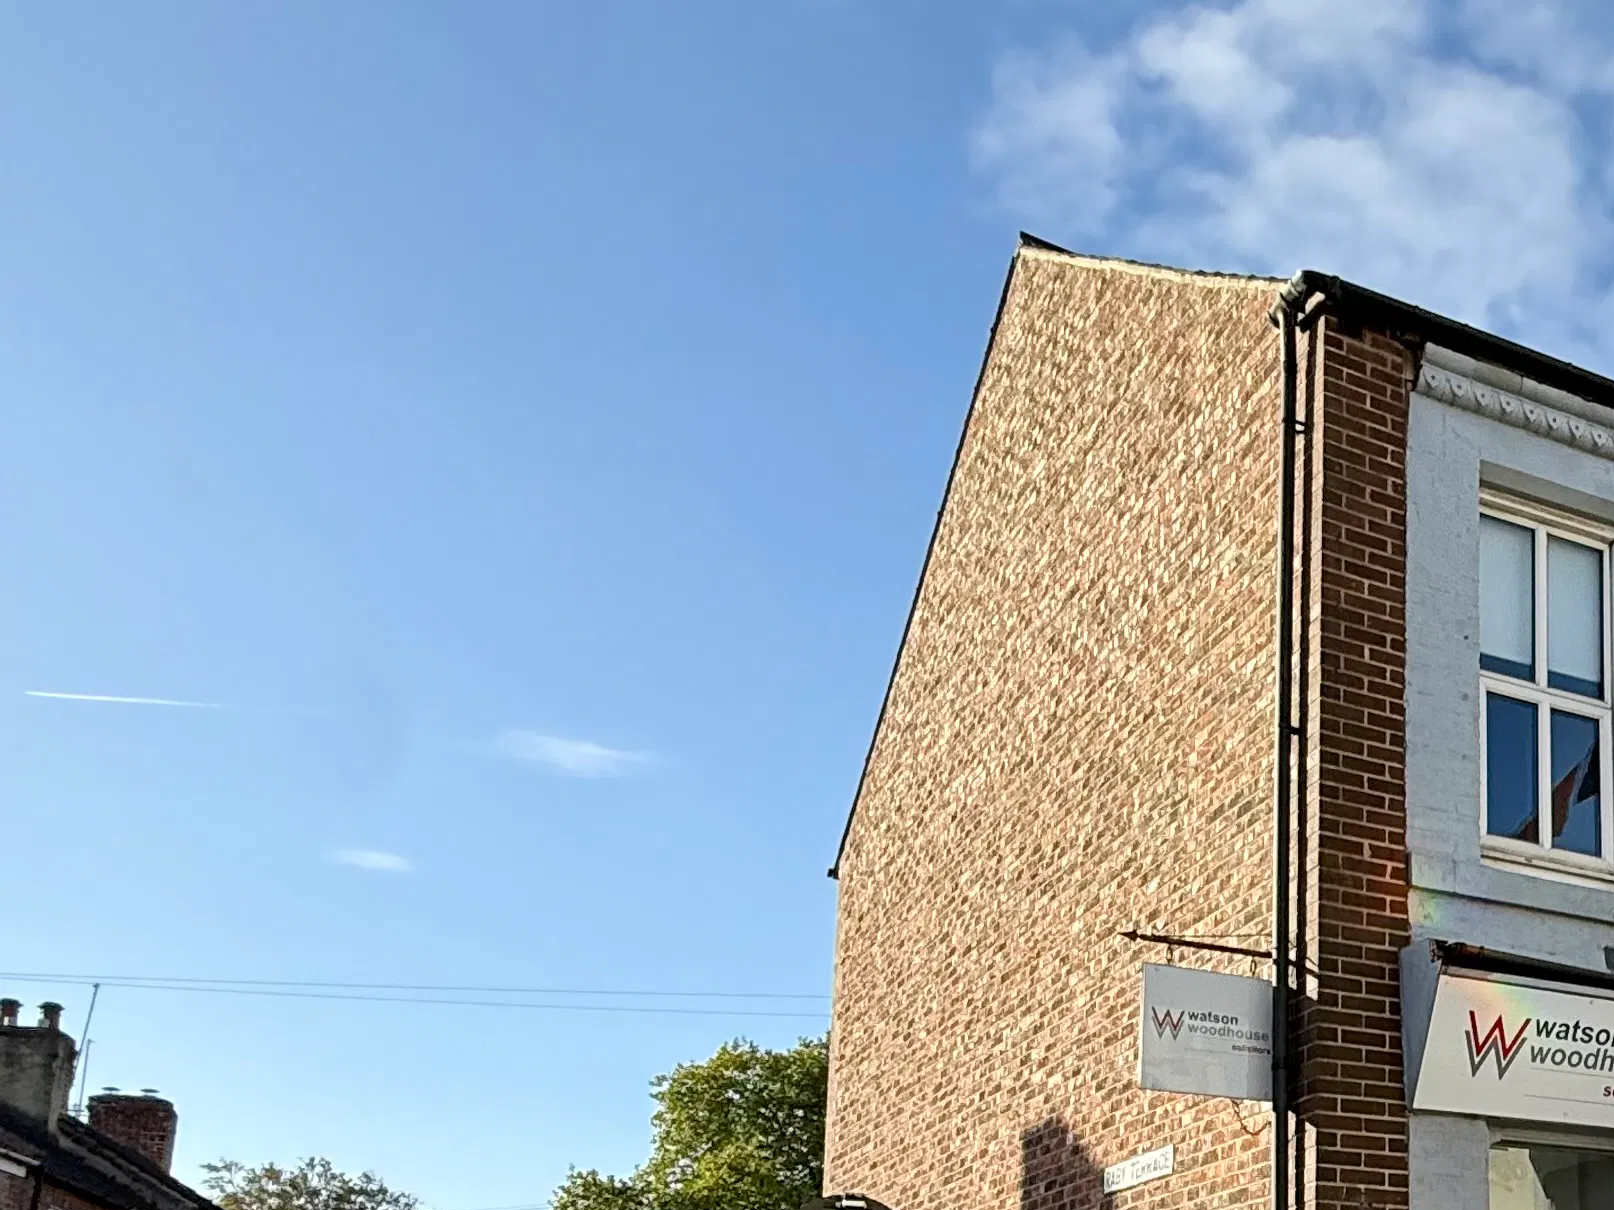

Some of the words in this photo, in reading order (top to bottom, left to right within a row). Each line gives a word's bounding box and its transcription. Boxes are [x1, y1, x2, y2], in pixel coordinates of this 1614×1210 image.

[1188, 1011, 1239, 1026] watson
[1188, 1024, 1269, 1042] woodhouse
[1130, 1151, 1171, 1180] TERRACE
